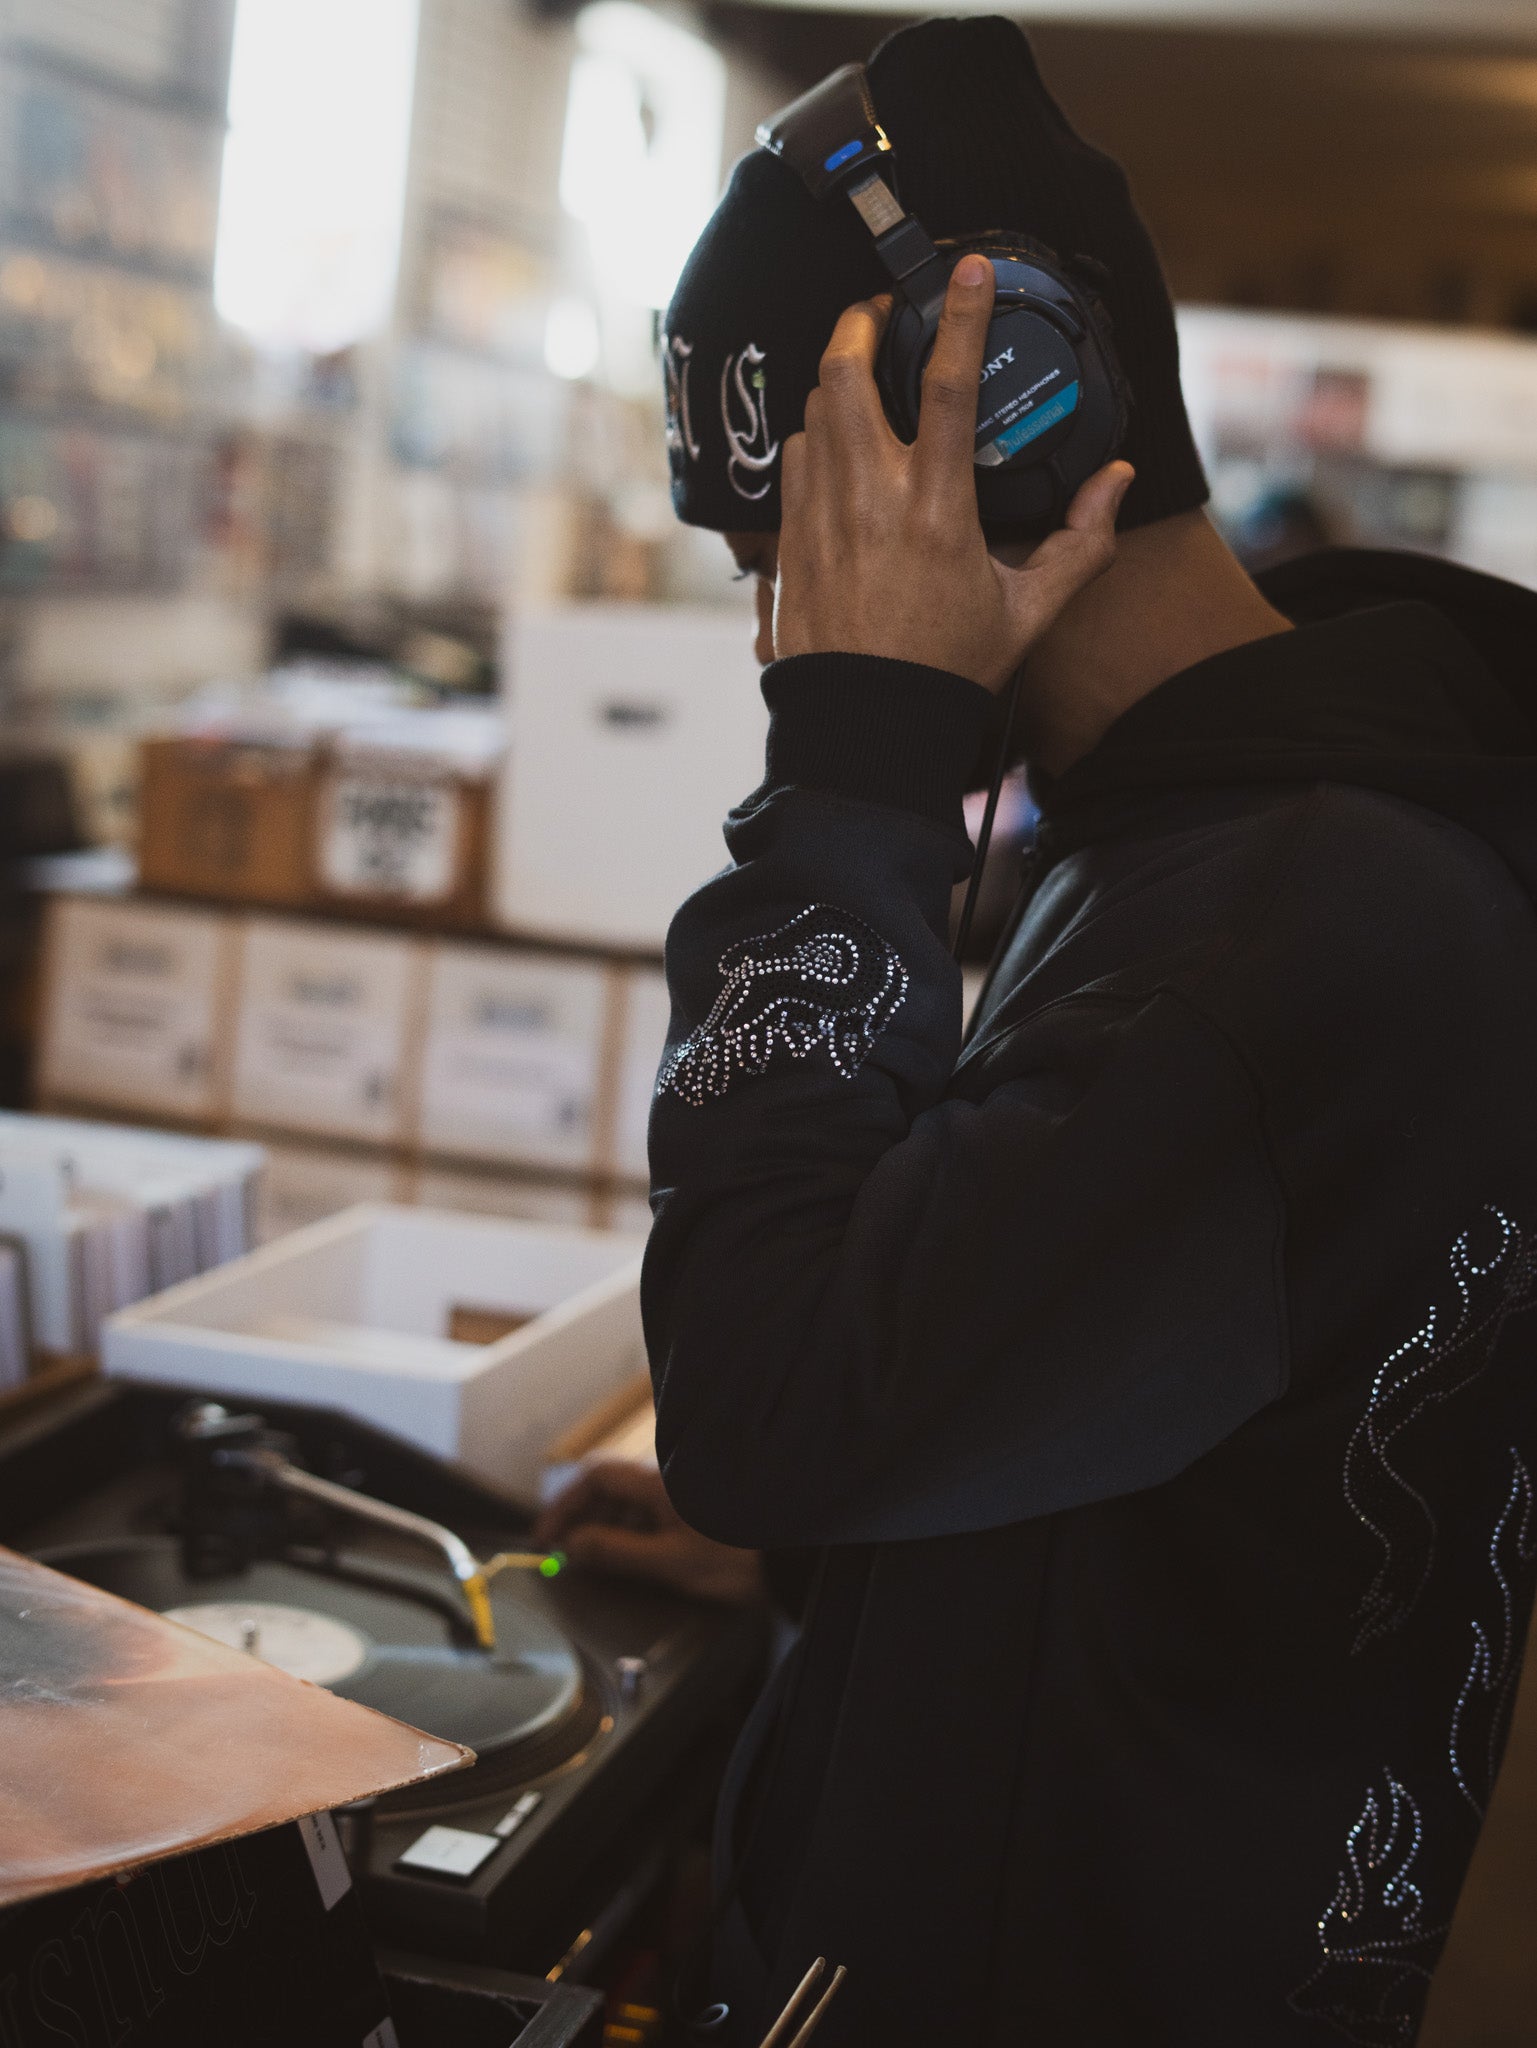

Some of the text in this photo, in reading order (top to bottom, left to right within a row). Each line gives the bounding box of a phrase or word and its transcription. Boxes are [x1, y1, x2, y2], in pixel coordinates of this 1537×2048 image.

[979, 347, 1015, 384] ONY
[994, 399, 1019, 420] STEREO
[1018, 368, 1061, 402] HEADPHONES
